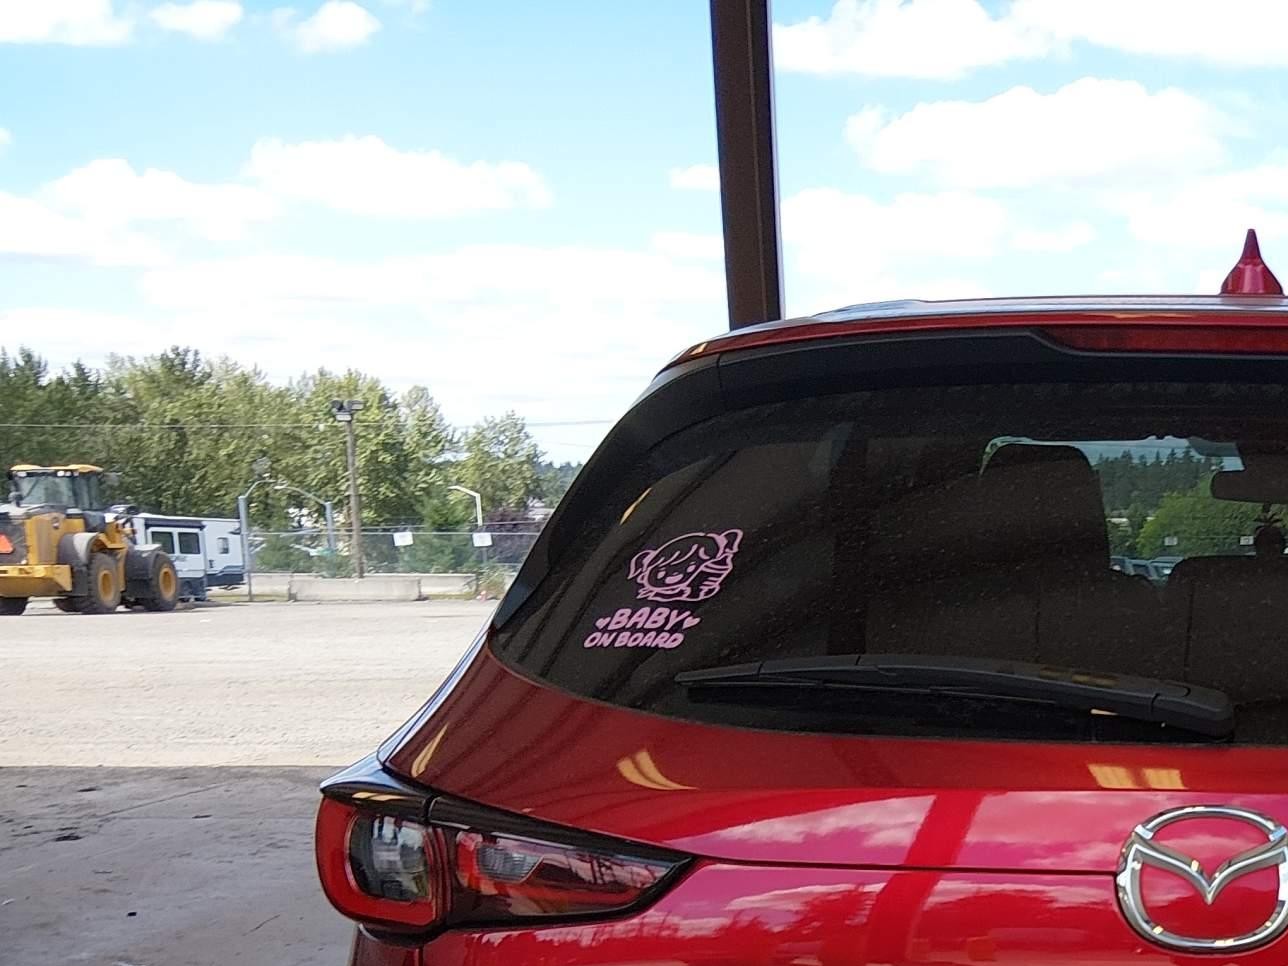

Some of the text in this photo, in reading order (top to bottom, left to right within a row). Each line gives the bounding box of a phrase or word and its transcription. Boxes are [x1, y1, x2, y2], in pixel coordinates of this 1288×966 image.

[607, 607, 692, 631] BABY
[583, 631, 685, 649] ON BOARD
